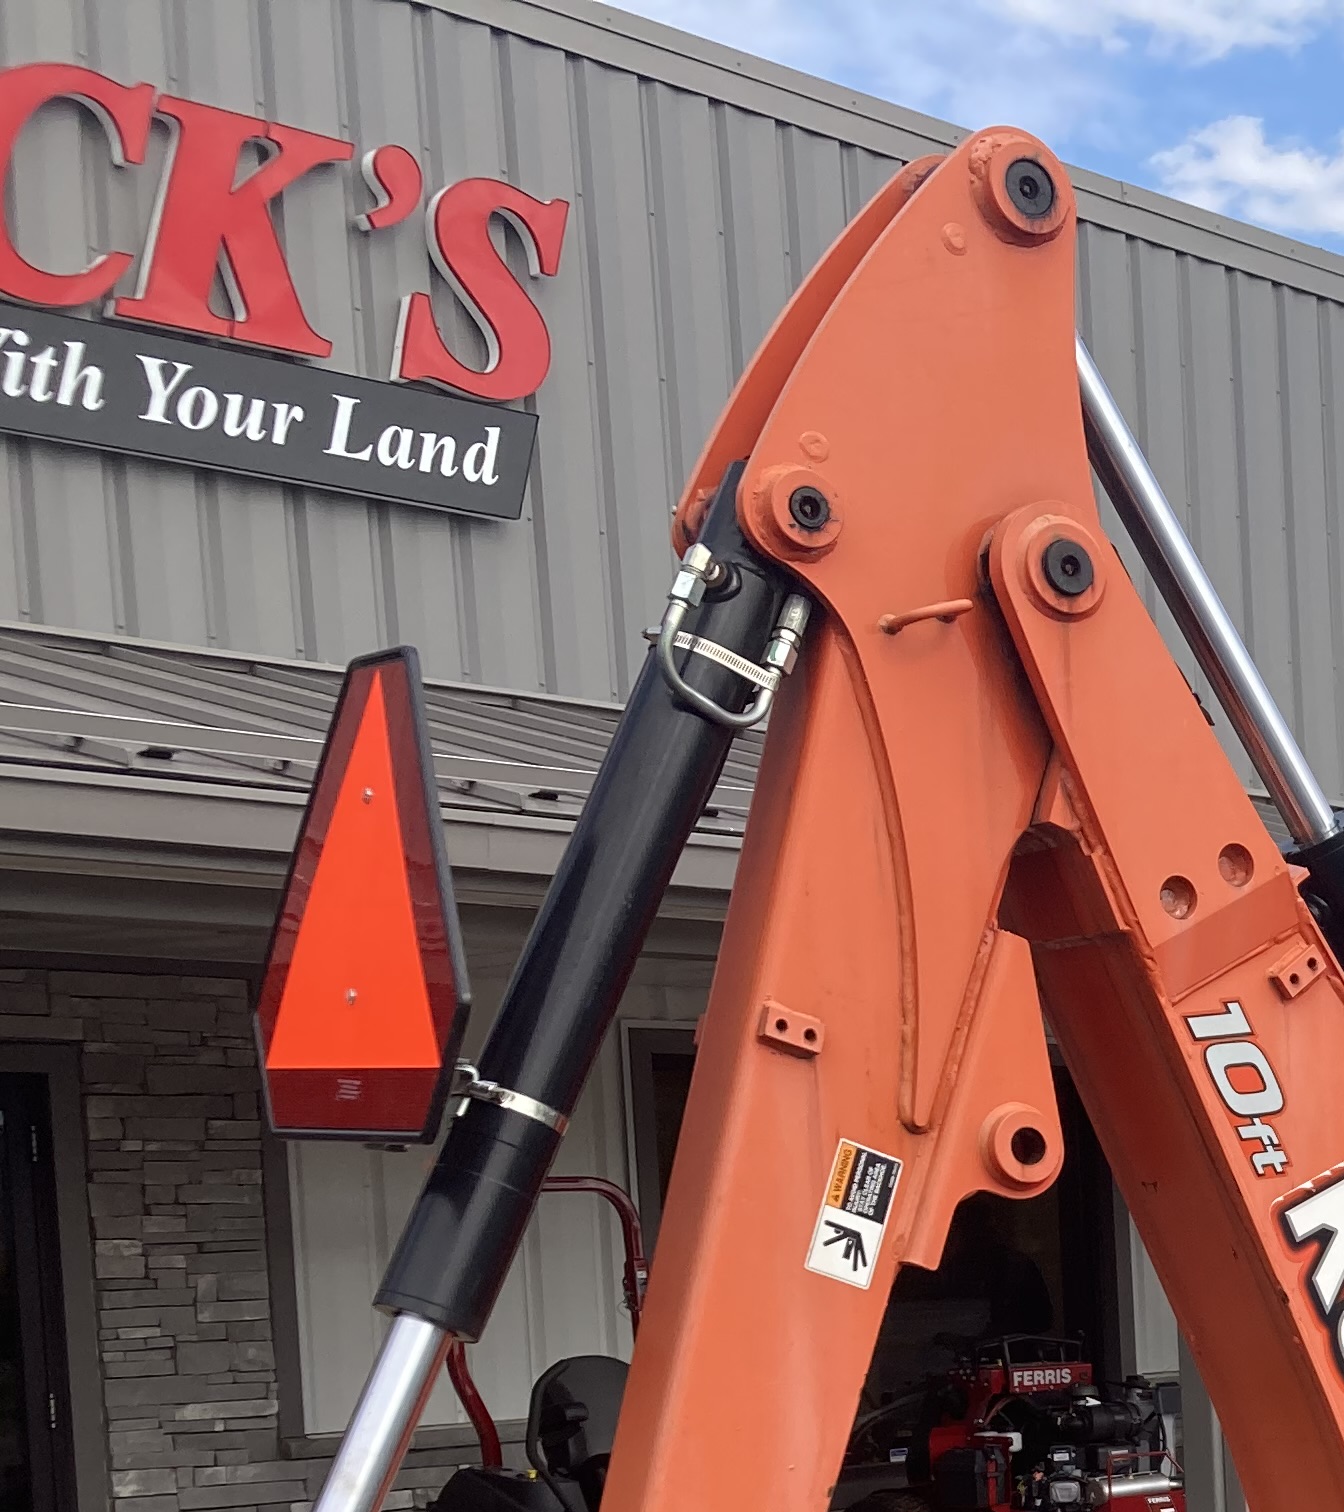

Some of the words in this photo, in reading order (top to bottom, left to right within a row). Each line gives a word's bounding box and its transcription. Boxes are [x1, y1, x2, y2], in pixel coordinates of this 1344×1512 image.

[0, 62, 570, 402] CK'S
[136, 354, 304, 446] Your
[323, 393, 501, 486] Land
[833, 1149, 852, 1191] WARNING
[1013, 1368, 1072, 1387] FERRIS
